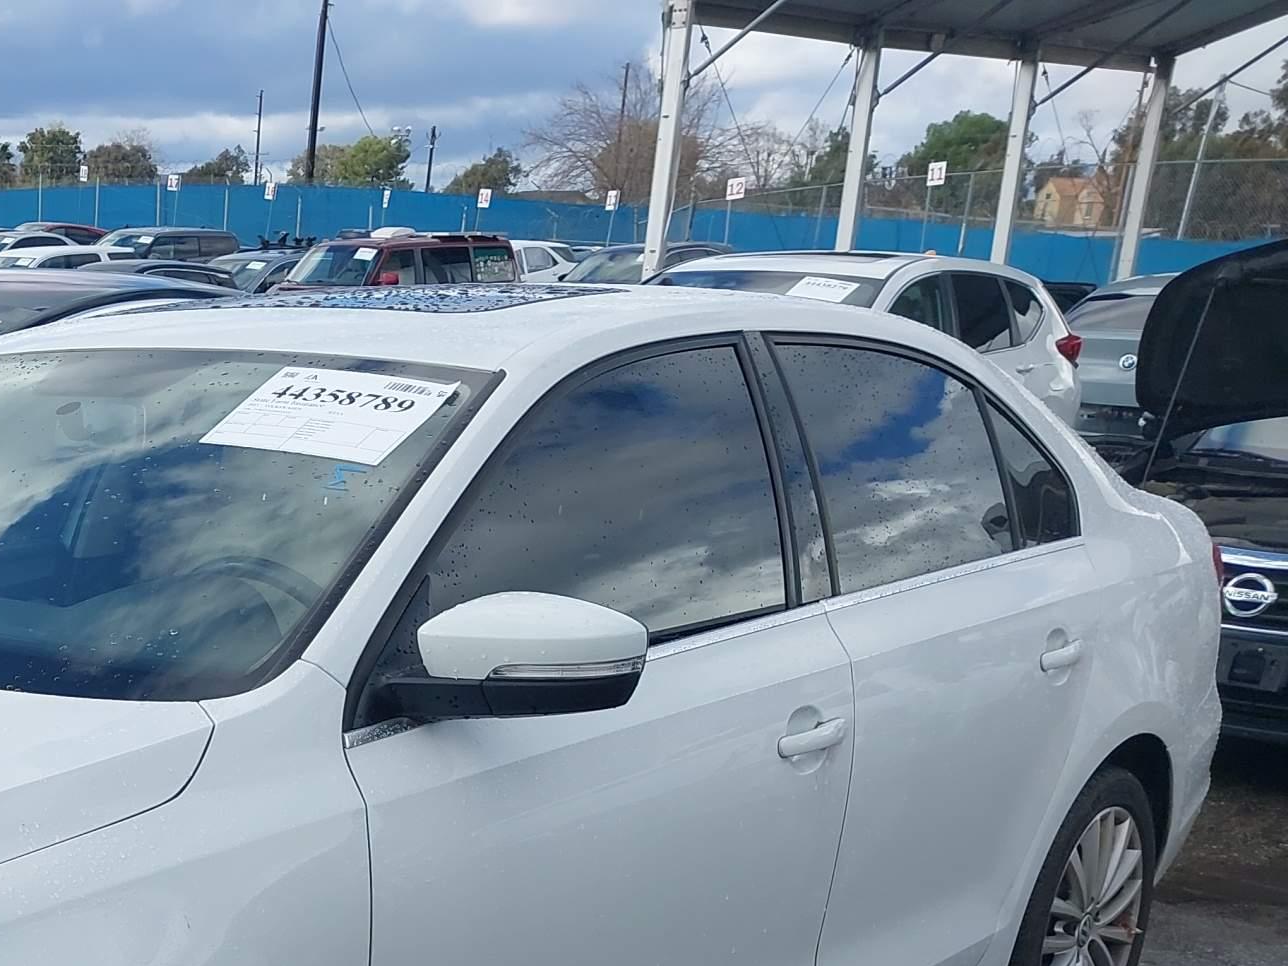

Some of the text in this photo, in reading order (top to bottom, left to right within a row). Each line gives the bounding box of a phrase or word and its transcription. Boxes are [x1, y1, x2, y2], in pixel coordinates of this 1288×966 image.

[928, 166, 943, 181] 11
[727, 182, 744, 196] 12
[271, 384, 416, 412] 44358789
[1224, 589, 1269, 601] NISSAN
